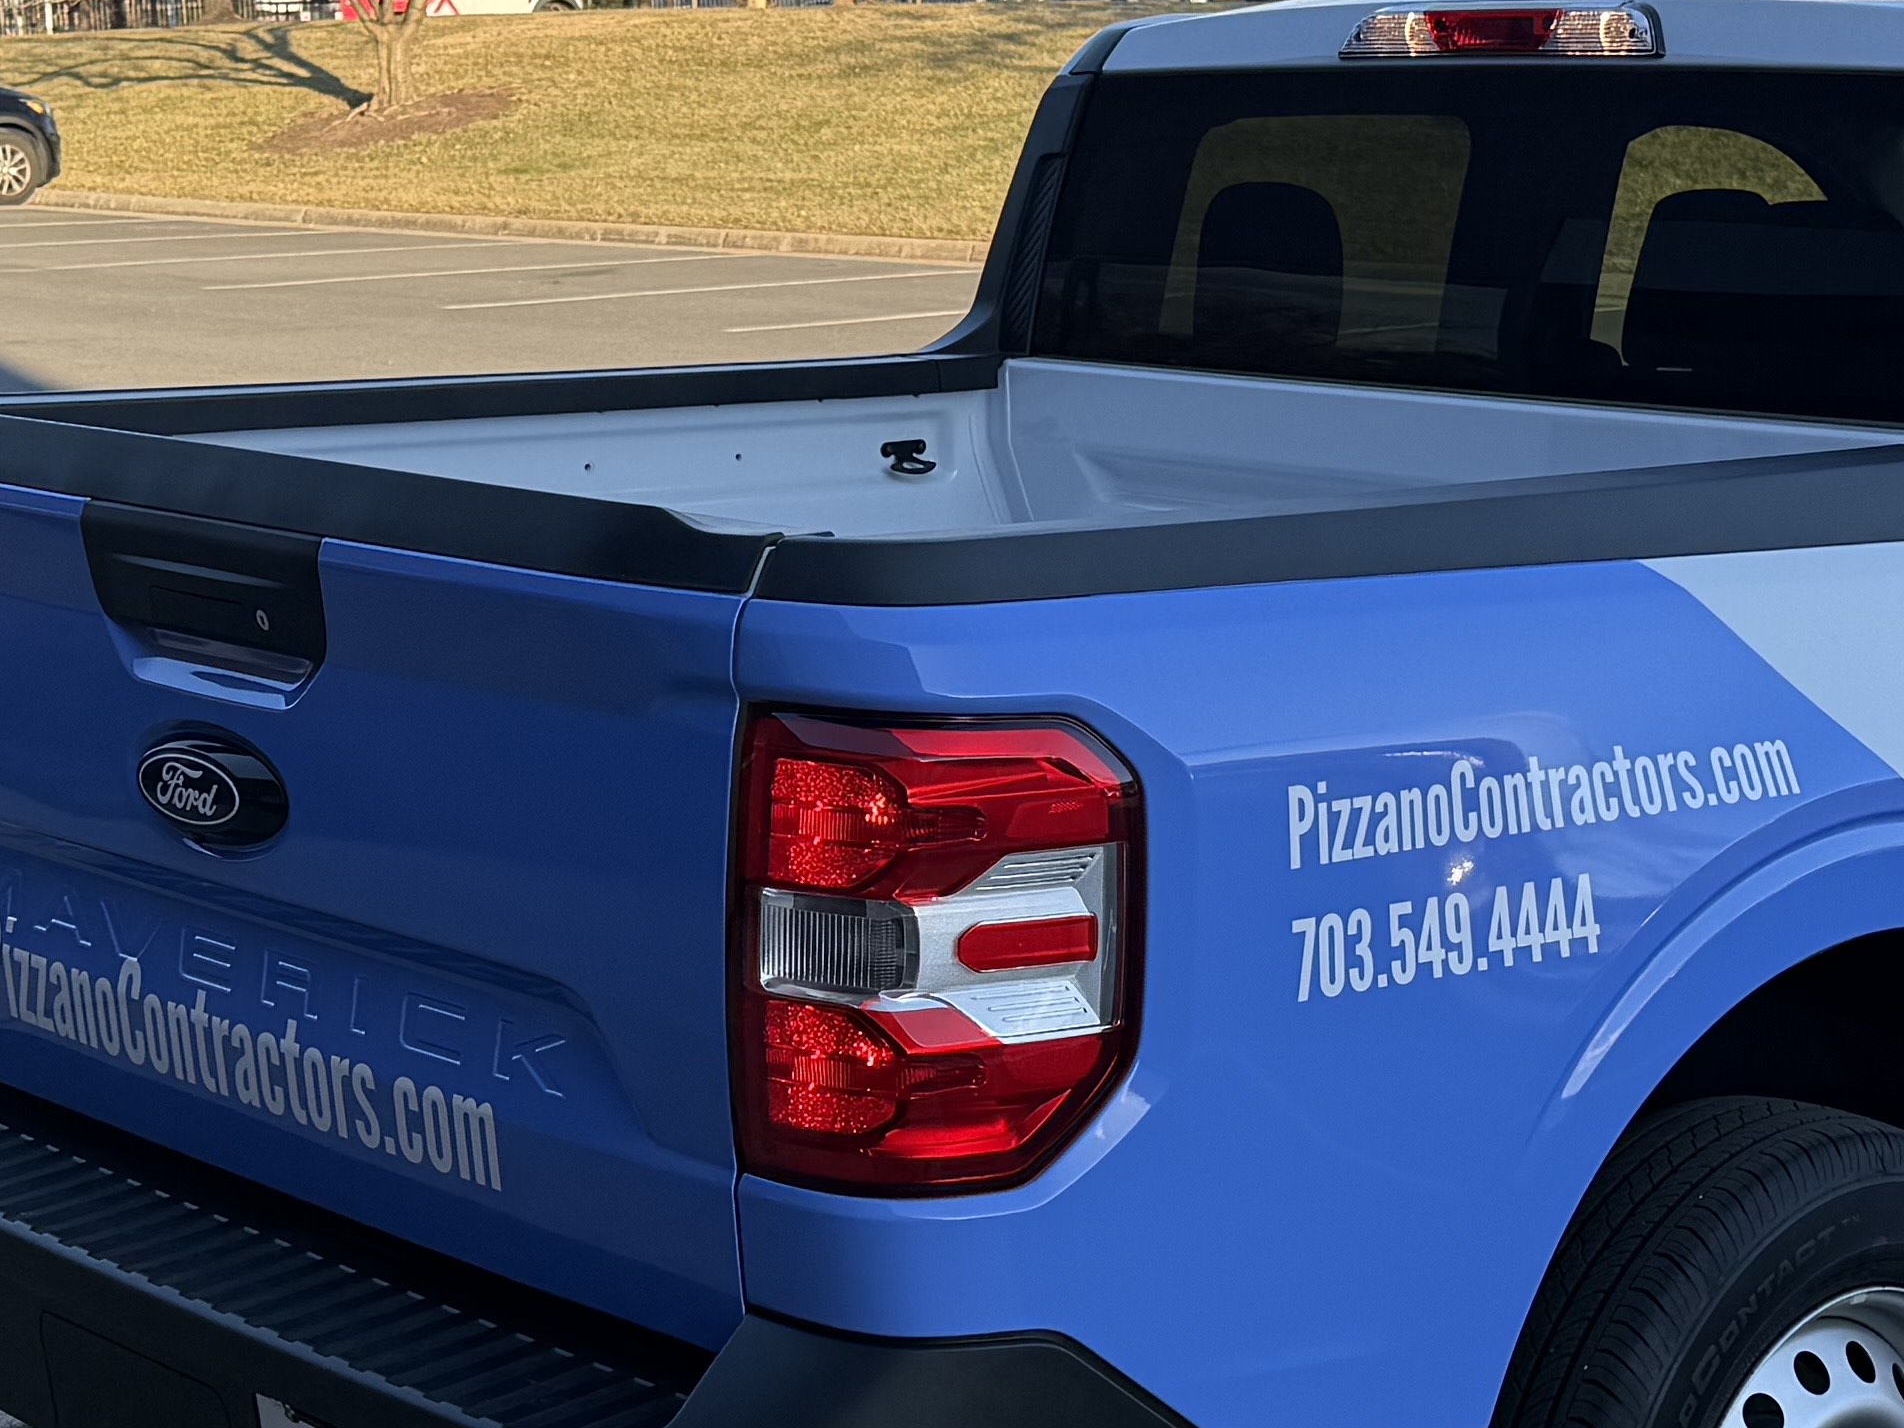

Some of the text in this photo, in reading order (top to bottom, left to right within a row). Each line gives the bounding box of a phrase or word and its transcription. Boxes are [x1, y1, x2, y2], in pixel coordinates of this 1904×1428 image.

[157, 761, 219, 817] Ford
[1287, 738, 1801, 870] PizzanoContractors.com
[1291, 872, 1600, 1002] 703.549.4444
